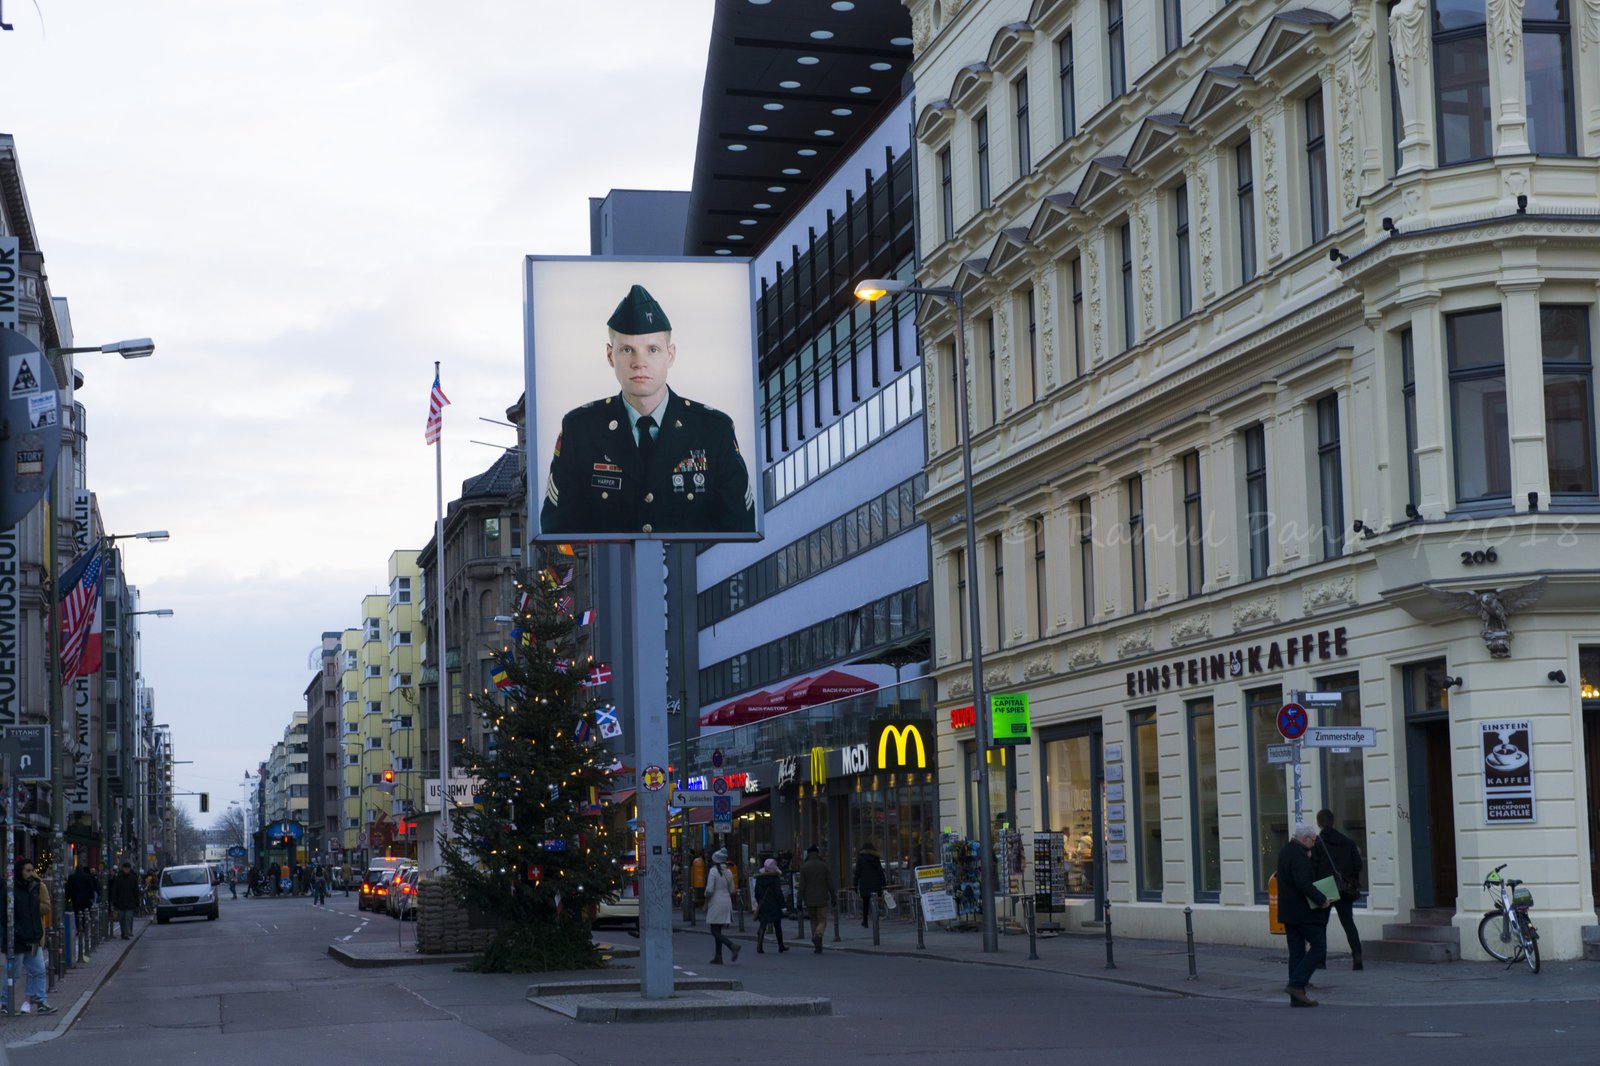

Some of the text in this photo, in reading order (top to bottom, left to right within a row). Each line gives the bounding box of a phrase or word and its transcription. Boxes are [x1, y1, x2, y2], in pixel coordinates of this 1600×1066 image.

[1460, 546, 1497, 565] 206
[1127, 627, 1348, 697] EINSTEIN KAFFEE
[1482, 722, 1529, 731] EINSTEIN
[1315, 730, 1365, 742] Zimmerstraße
[1487, 776, 1529, 785] KAFFEE
[1488, 809, 1530, 817] CHARLIE
